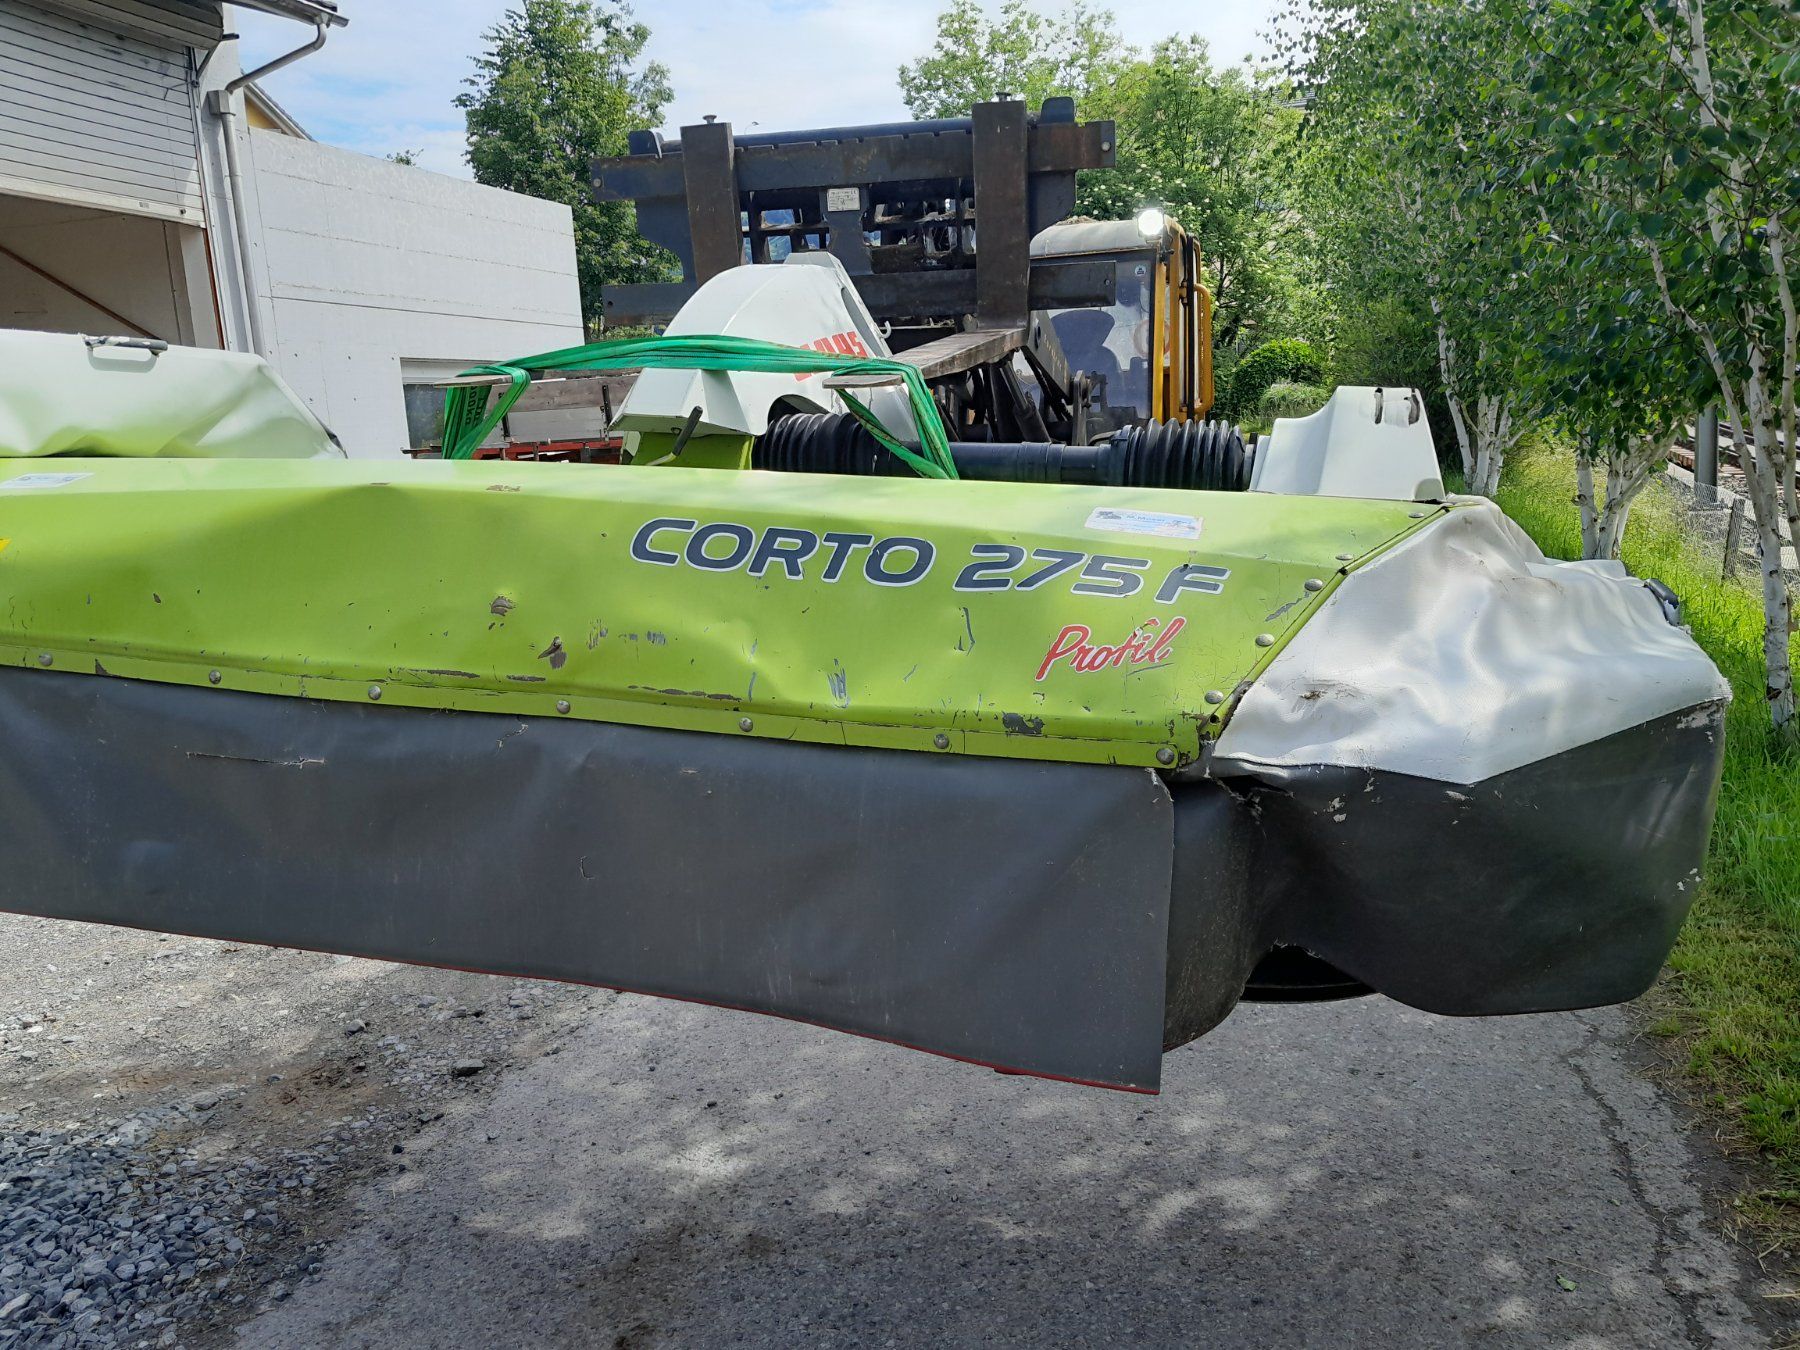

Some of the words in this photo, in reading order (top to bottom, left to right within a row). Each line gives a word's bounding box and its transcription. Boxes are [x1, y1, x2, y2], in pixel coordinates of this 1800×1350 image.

[630, 517, 937, 588] CORTO
[952, 543, 1152, 598] 275
[1153, 563, 1232, 605] F
[1034, 616, 1187, 682] Profil
